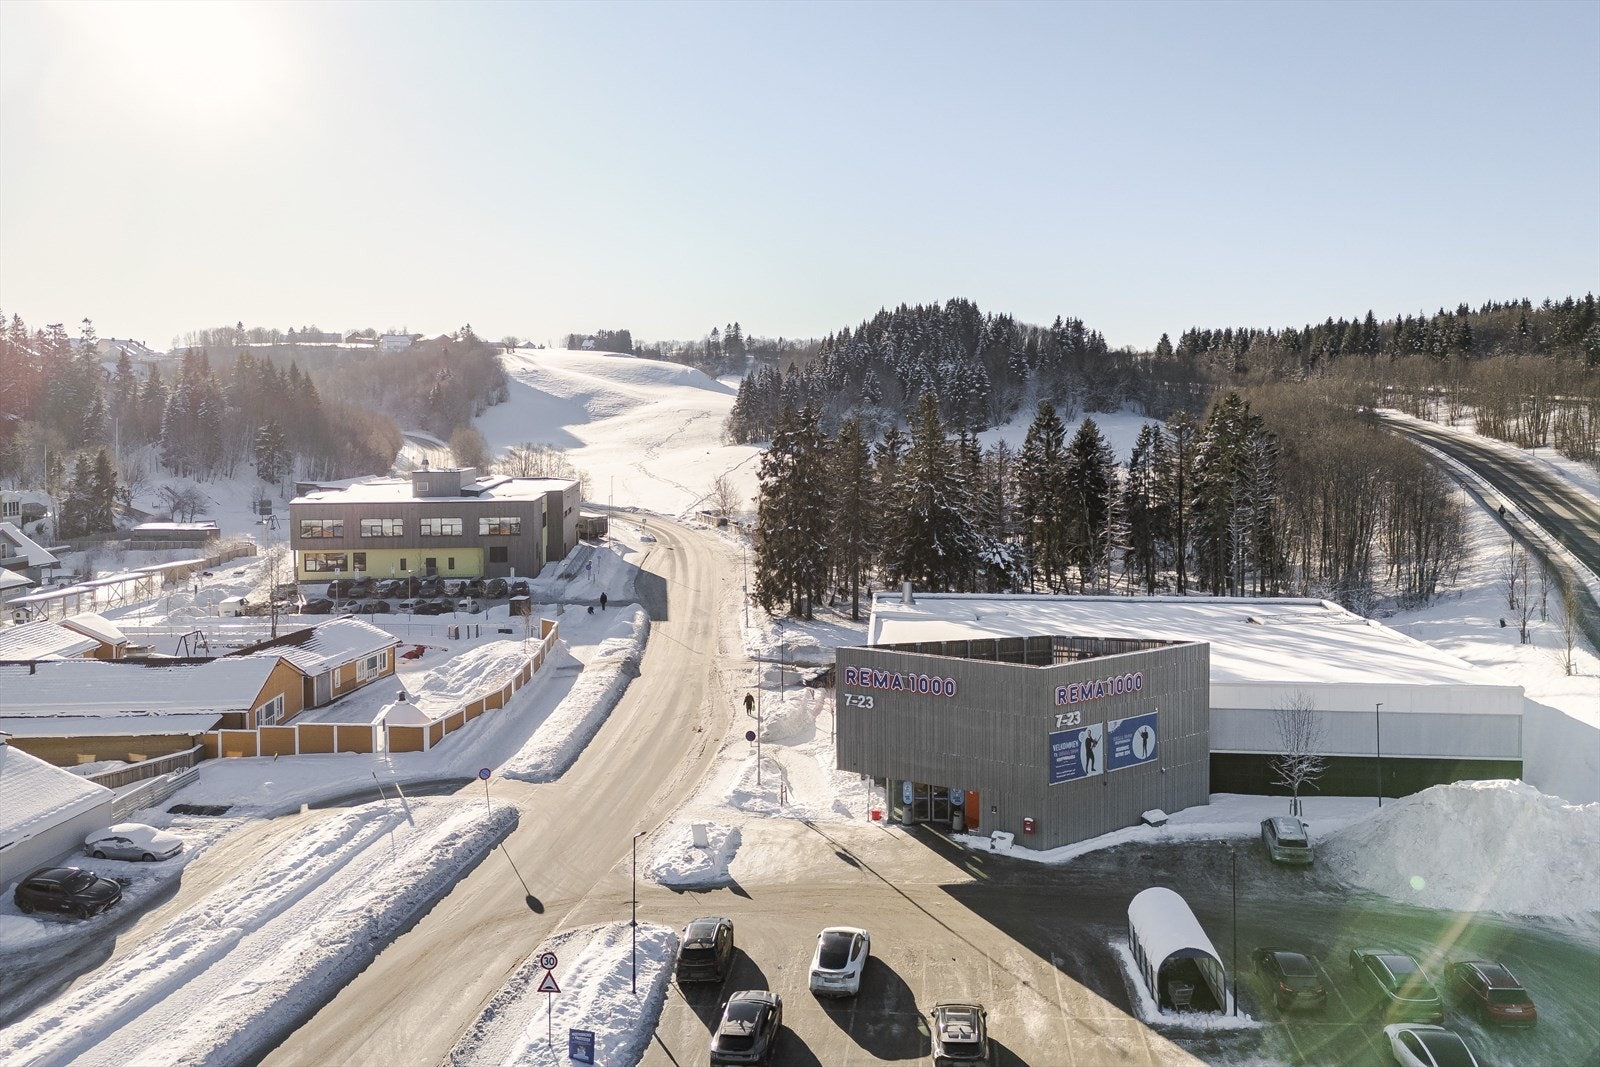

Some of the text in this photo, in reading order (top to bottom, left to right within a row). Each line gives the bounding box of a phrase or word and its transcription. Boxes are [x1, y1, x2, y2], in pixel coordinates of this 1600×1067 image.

[845, 666, 956, 697] REMA 1000
[1055, 672, 1143, 706] REMA 1000
[845, 693, 874, 709] 7-23
[1055, 711, 1081, 728] 7-23
[544, 957, 554, 965] 30
